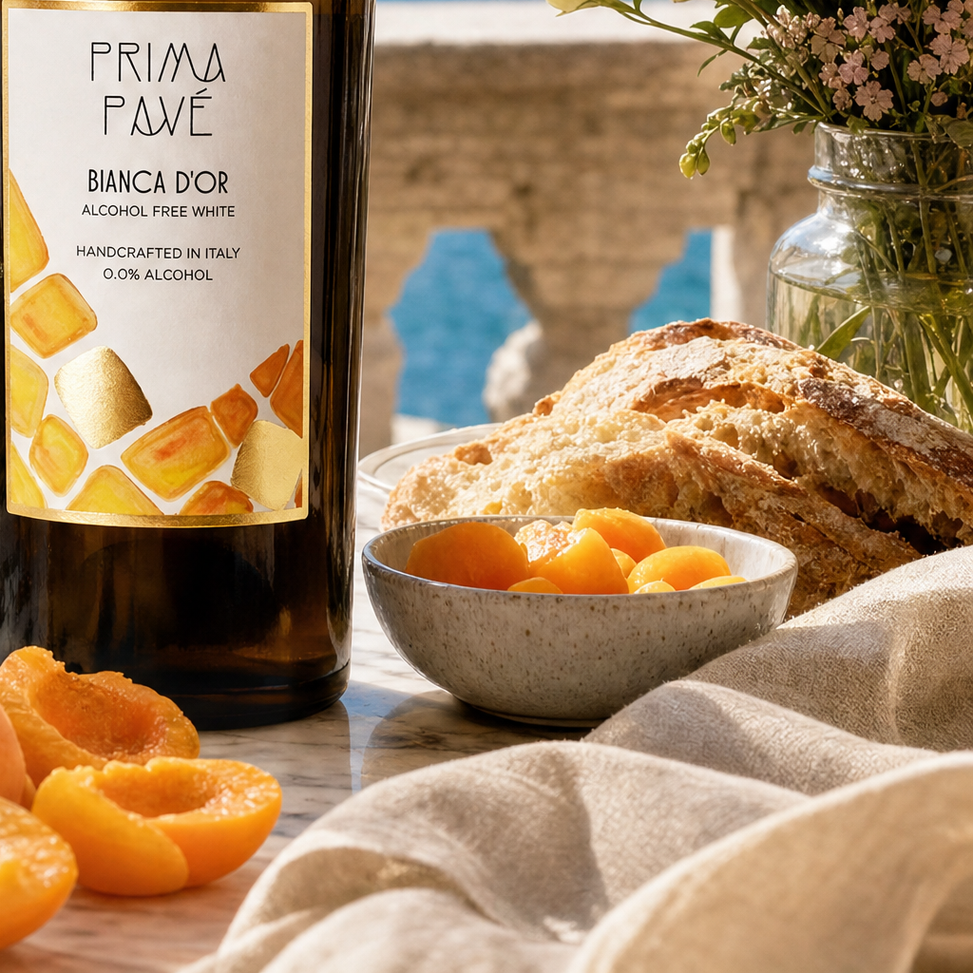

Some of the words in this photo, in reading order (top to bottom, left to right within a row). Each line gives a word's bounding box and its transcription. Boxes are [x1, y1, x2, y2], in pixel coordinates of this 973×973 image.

[90, 41, 226, 82] PRIMA
[104, 87, 213, 136] PAVÉ
[88, 169, 166, 194] BIANCA
[175, 170, 229, 194] D'OR
[81, 204, 148, 217] ALCOHOL
[152, 205, 188, 218] FREE
[191, 205, 236, 218] WHITE
[76, 245, 183, 259] HANDCRAFTED
[186, 246, 201, 259] IN
[205, 246, 241, 259] ITALY
[103, 267, 141, 281] 0.0%
[144, 268, 213, 281] ALCOHOL
